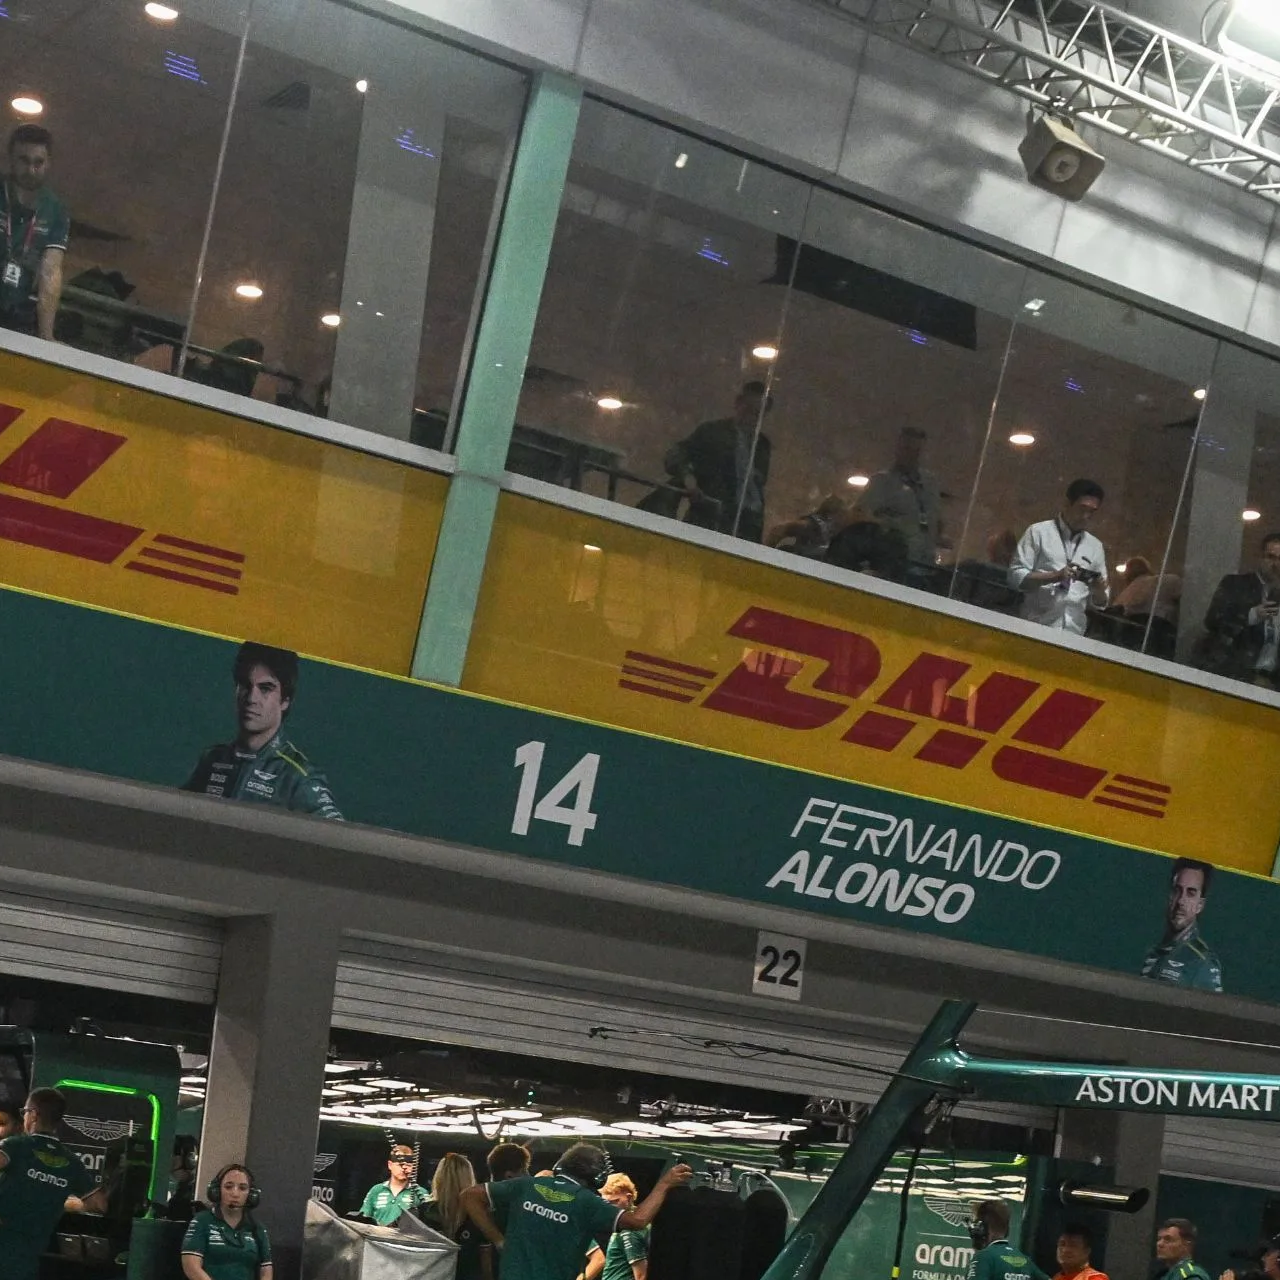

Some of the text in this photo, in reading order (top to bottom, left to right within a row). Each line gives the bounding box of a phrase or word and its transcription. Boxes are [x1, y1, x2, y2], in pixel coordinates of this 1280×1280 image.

[702, 606, 1107, 799] DHL
[514, 740, 601, 847] 14
[790, 797, 1062, 891] FERNANDO
[766, 849, 976, 924] ALONSO
[757, 944, 803, 988] 22
[1075, 1075, 1189, 1110] ASTON
[522, 1200, 569, 1225] aramco
